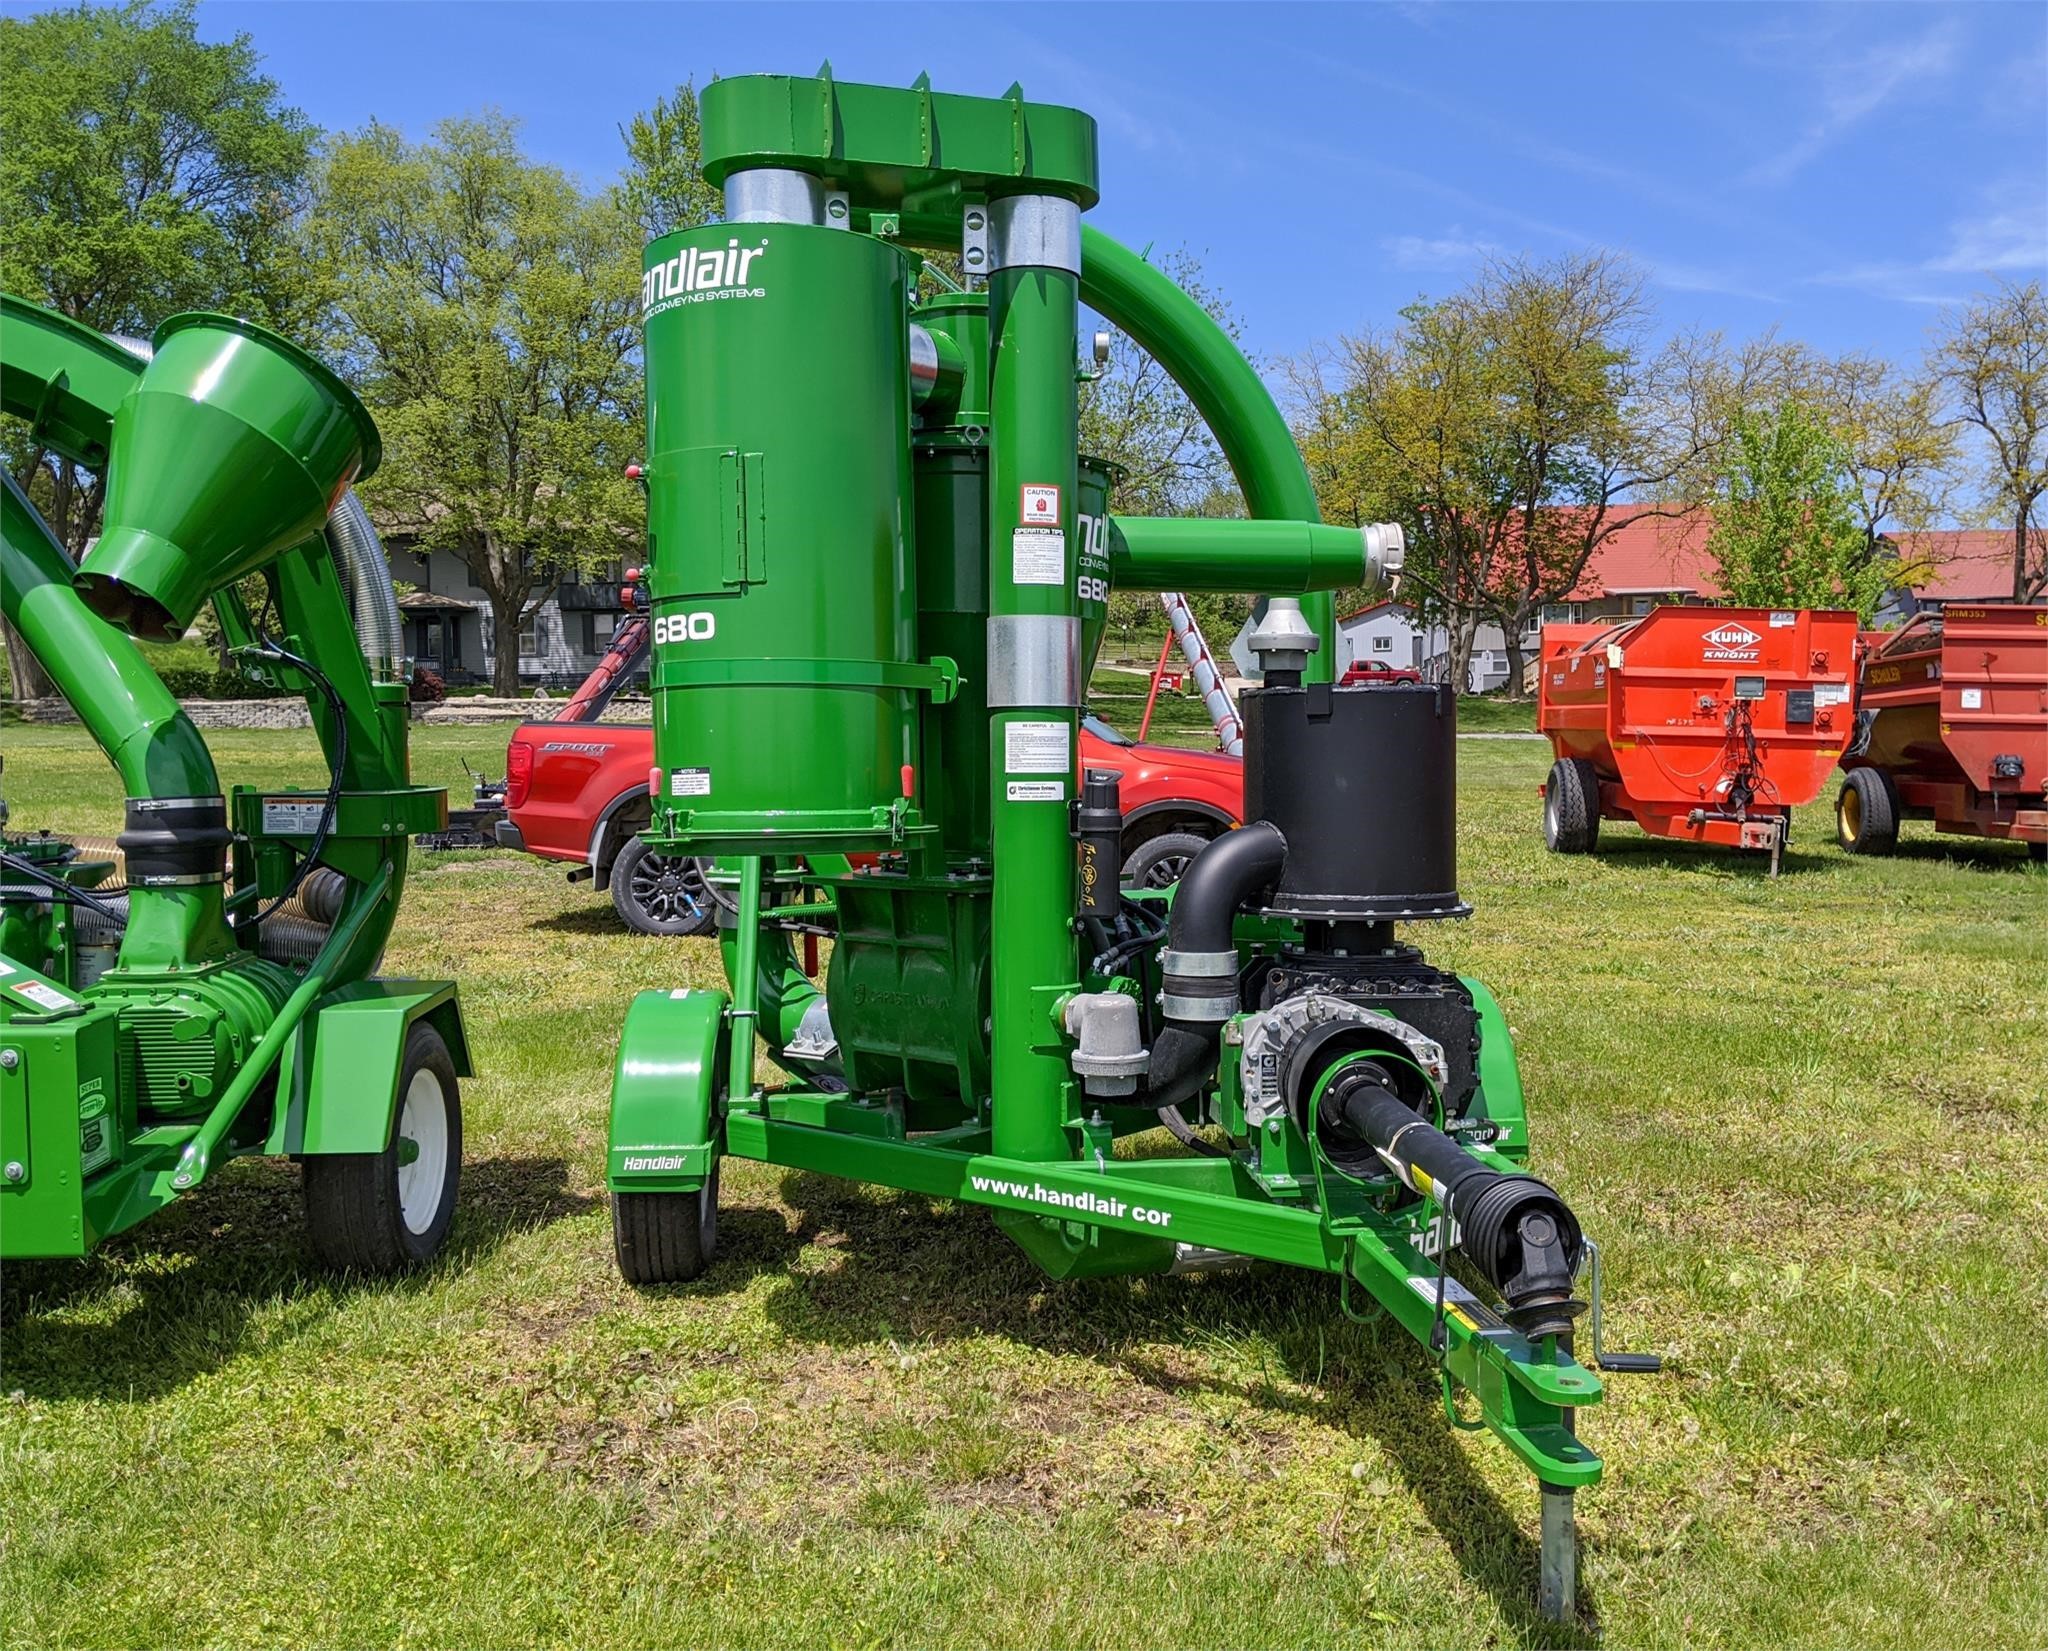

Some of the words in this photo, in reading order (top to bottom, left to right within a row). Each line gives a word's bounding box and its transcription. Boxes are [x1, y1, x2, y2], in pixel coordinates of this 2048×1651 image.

[706, 288, 766, 301] SYSTEMS
[1026, 488, 1056, 497] CAUTION
[1014, 527, 1051, 535] OPERATION
[1051, 528, 1064, 536] TIPS
[1078, 575, 1108, 604] 680
[654, 612, 715, 645] 680
[1711, 631, 1753, 644] KUHN
[1704, 650, 1760, 660] KNIGHT
[540, 742, 615, 753] SPORT
[623, 1155, 685, 1171] Handlair
[971, 1176, 1128, 1218] www.handlair
